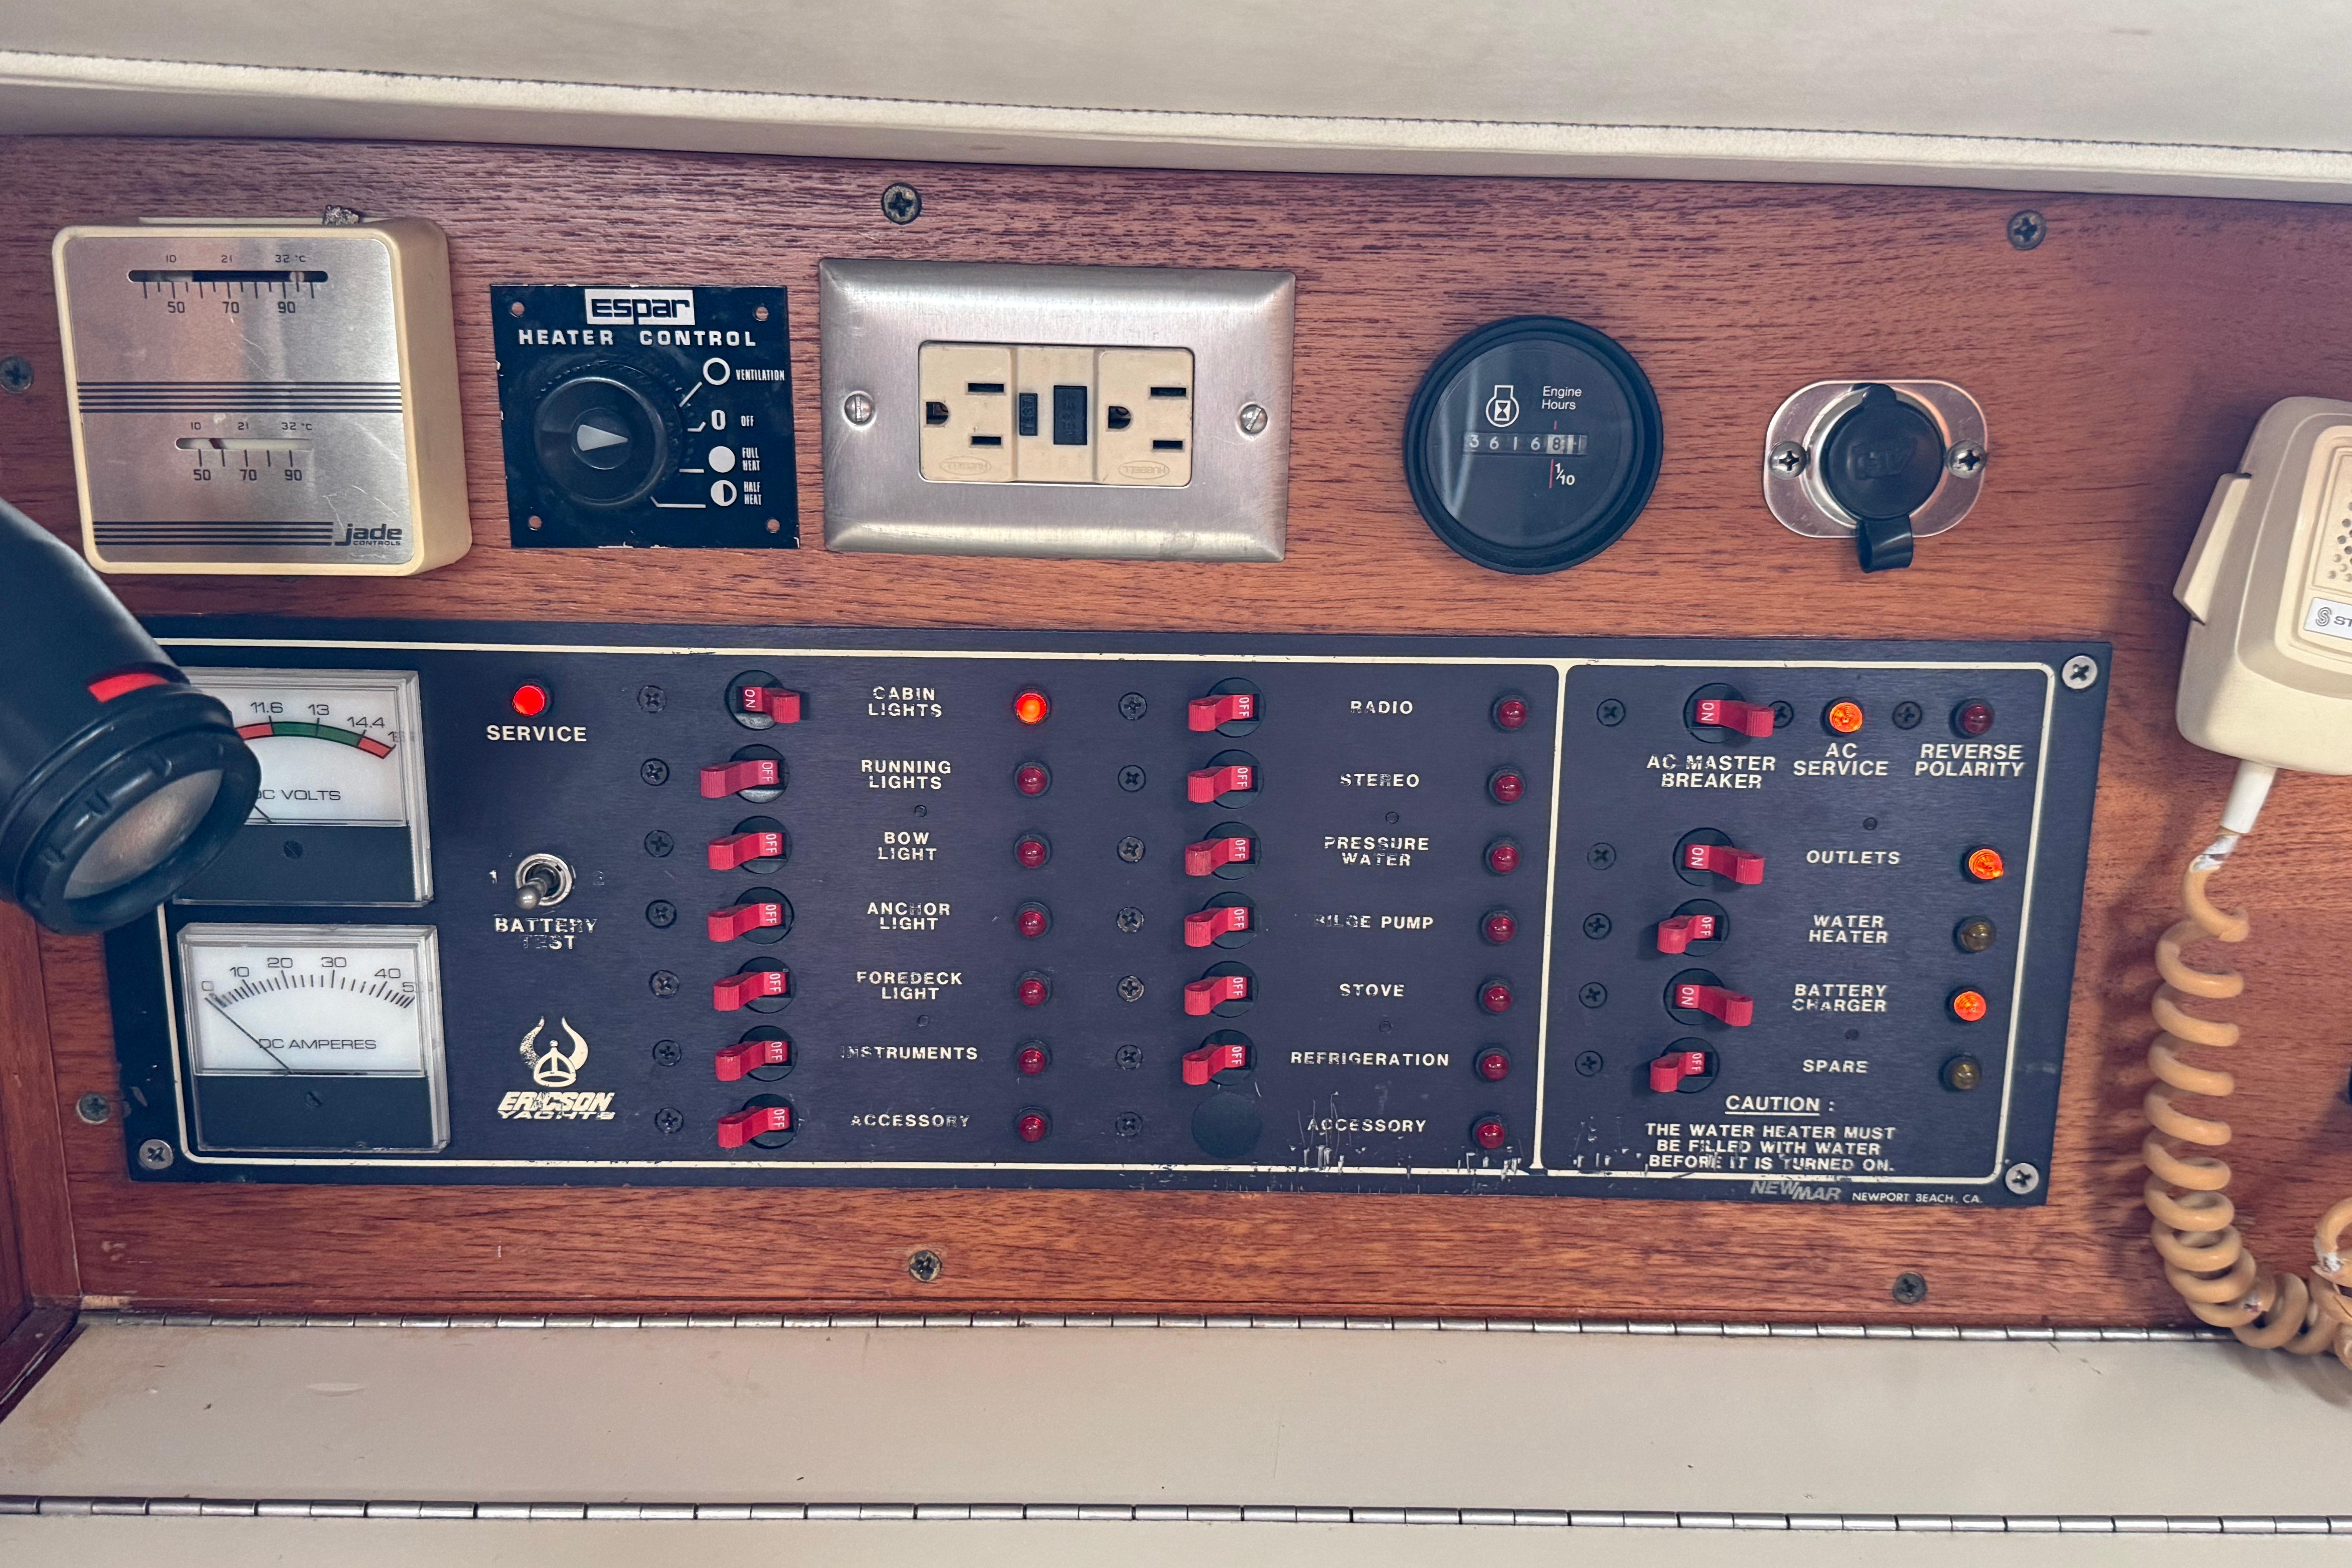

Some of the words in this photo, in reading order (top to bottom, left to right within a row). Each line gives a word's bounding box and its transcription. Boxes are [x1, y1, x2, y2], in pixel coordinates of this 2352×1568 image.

[168, 301, 185, 313] 50
[223, 301, 239, 314] 70
[278, 301, 295, 314] 90
[592, 298, 690, 324] Espar
[519, 330, 613, 345] HEATER
[640, 331, 756, 346] CONTROL
[736, 369, 785, 381] VENTILATION
[1543, 386, 1582, 399] Engine
[1542, 400, 1576, 410] Hours
[741, 416, 754, 427] OFF
[742, 447, 759, 458] FULL
[743, 460, 760, 471] HEAT
[193, 469, 211, 481] 50
[239, 469, 257, 481] 70
[285, 469, 302, 481] 90
[744, 481, 761, 492] HALF
[744, 494, 761, 505] HEAT
[336, 523, 402, 545] jade
[745, 689, 755, 708] ON
[873, 687, 935, 700] CABIN
[251, 702, 283, 713] 11.6
[308, 704, 329, 715] 13
[868, 704, 943, 717] LIGHTS
[1239, 697, 1249, 718] OFF
[1351, 701, 1413, 714] RADIO
[1702, 702, 1714, 722] ON
[347, 717, 385, 728] 14.4
[487, 725, 587, 742] SERVICE
[1826, 743, 1857, 758] AC
[1921, 744, 2023, 760] REVERSE
[861, 760, 951, 774] RUNNING
[1647, 754, 1676, 770] AC
[1687, 756, 1776, 772] MASTER
[1794, 761, 1889, 776] SERVICE
[1915, 761, 2026, 777] POLARITY
[763, 762, 773, 784] OFF
[1237, 767, 1248, 789] OFF
[1340, 773, 1420, 787] STEREO
[869, 777, 942, 789] LIGHTS
[1661, 774, 1762, 789] BREAKER
[257, 790, 275, 799] C
[281, 790, 341, 800] VOLTS
[765, 833, 777, 854] OFF
[884, 832, 930, 845] BOW
[1324, 836, 1429, 850] PRESSURE
[878, 847, 937, 861] LIGHT
[1235, 839, 1246, 860] OFF
[1691, 847, 1704, 866] ON
[1342, 852, 1411, 866] WATER
[1807, 850, 1900, 865] OUTLETS
[765, 904, 777, 925] OFF
[867, 902, 950, 915] ANCHOR
[495, 918, 597, 933] BATTERY
[880, 917, 938, 930] LIGHT
[1234, 908, 1244, 929] OFF
[1381, 916, 1433, 929] PUMP
[1814, 915, 1883, 928] WATER
[1701, 916, 1712, 936] OFF
[1809, 930, 1888, 944] HEATER
[267, 958, 293, 968] 20
[321, 957, 347, 967] 30
[230, 967, 249, 977] 10
[375, 969, 401, 979] 40
[857, 971, 962, 985] FOREDECK
[202, 981, 213, 991] 0
[770, 973, 781, 994] OFF
[1233, 978, 1243, 997] OFF
[1340, 983, 1405, 997] STOVE
[1795, 984, 1888, 997] BATTERY
[882, 987, 939, 1000] LIGHT
[1682, 987, 1694, 1006] ON
[1793, 999, 1887, 1012] CHARGER
[259, 1039, 284, 1049] DC
[289, 1040, 376, 1049] AMPERES
[771, 1042, 783, 1062] OFF
[840, 1046, 978, 1059] INSTRUMENTS
[1232, 1046, 1242, 1066] OFF
[1291, 1052, 1449, 1066] REFRIGERATION
[1692, 1052, 1703, 1073] OFF
[1803, 1059, 1869, 1073] SPARE
[498, 1092, 615, 1111] ERICSON
[1726, 1095, 1820, 1111] CAUTION
[498, 1111, 615, 1120] YACHTS
[774, 1108, 785, 1129] OFF
[851, 1115, 970, 1128] ACCESSORY
[1307, 1119, 1426, 1132] ACCESSORY
[1645, 1123, 1680, 1136] THE
[1689, 1124, 1755, 1138] WATER
[1763, 1125, 1835, 1139] HEATER
[1844, 1126, 1896, 1140] MUST
[1657, 1139, 1679, 1152] BE
[1689, 1140, 1750, 1153] FILLED
[1760, 1141, 1806, 1154] WITH
[1815, 1142, 1880, 1155] WATER
[1649, 1155, 1722, 1169] BEFORE
[1730, 1156, 1748, 1170] IT
[1755, 1156, 1772, 1170] IS
[1783, 1155, 1854, 1171] TURNED
[1853, 1192, 1909, 1202] NEWPORT
